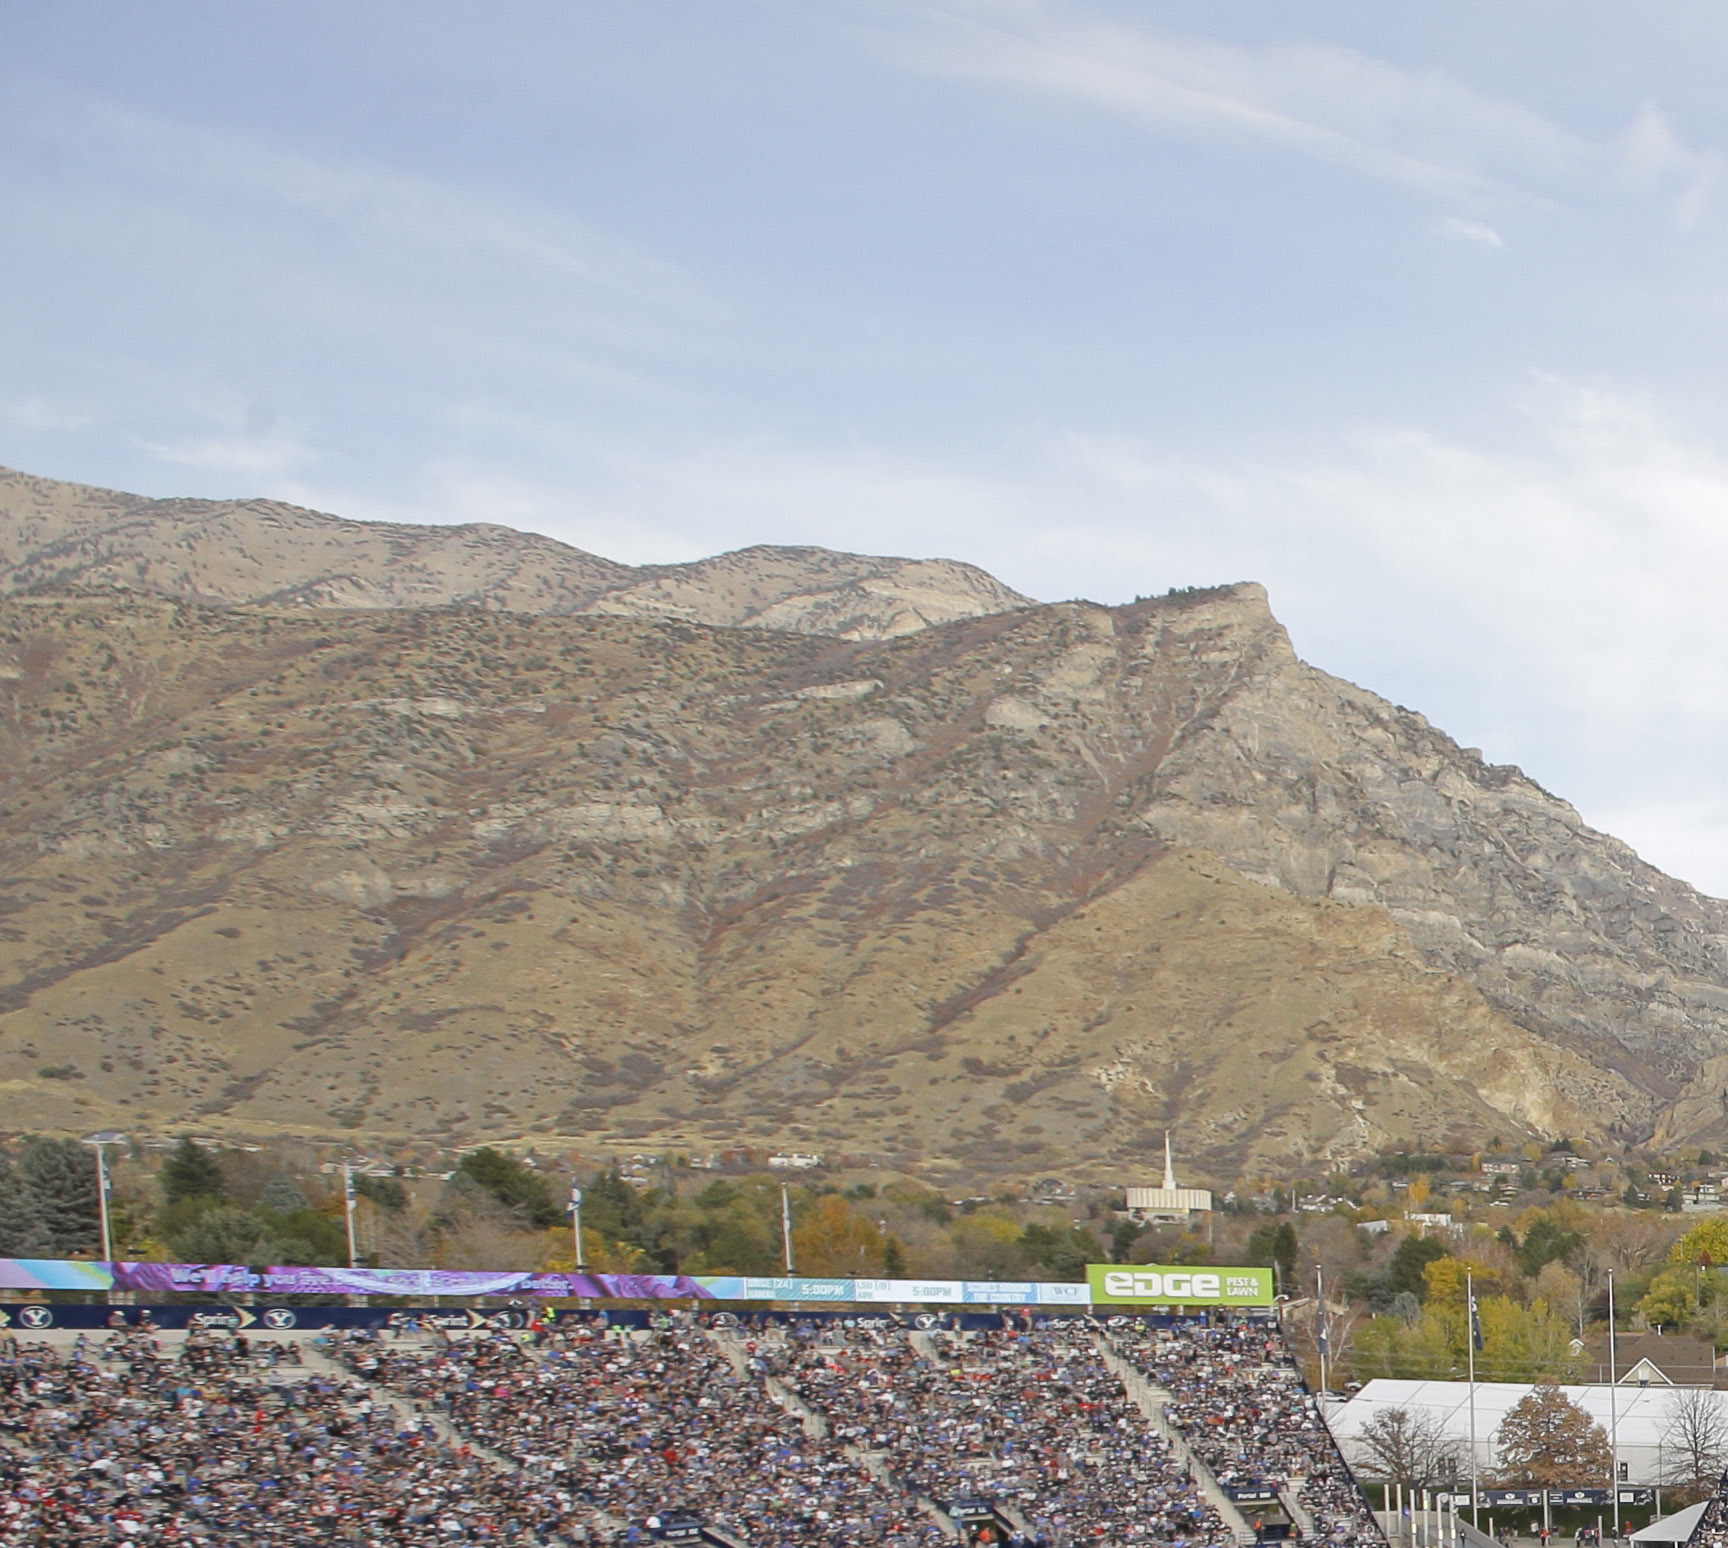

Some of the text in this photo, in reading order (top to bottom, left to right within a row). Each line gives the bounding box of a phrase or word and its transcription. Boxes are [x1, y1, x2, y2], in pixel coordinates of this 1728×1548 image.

[1226, 1277, 1259, 1287] PEST &
[1226, 1287, 1258, 1297] LAWN
